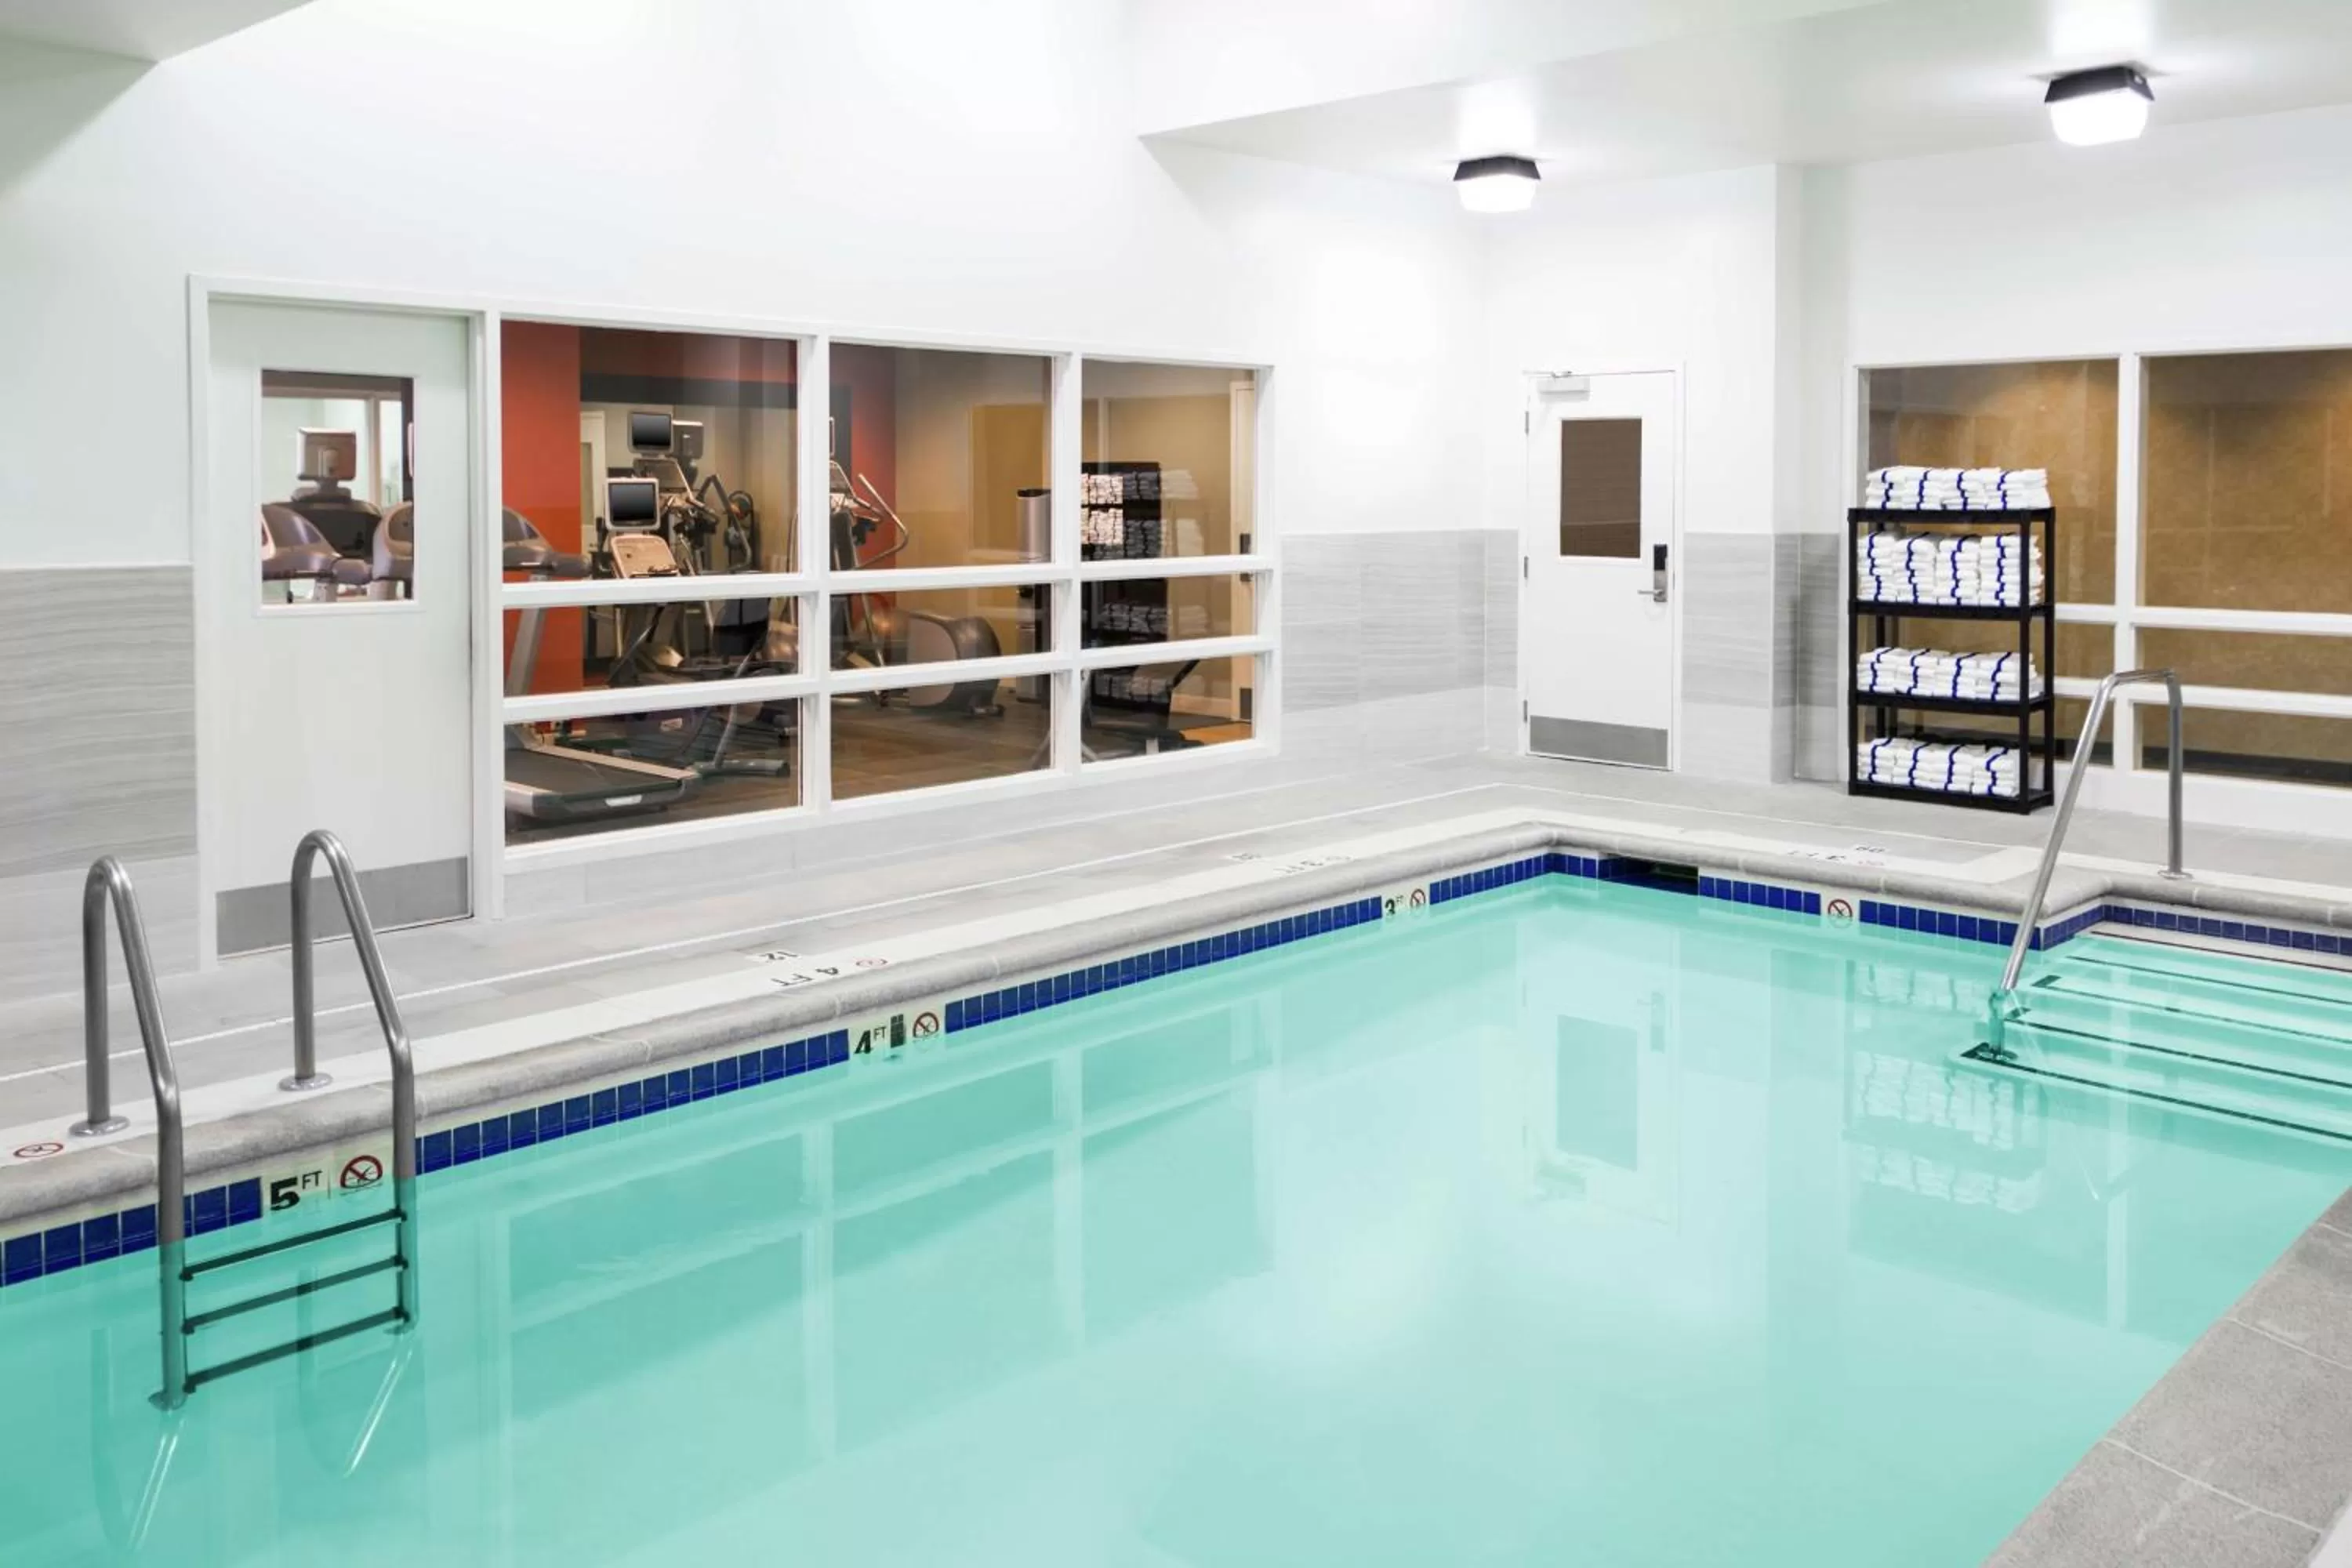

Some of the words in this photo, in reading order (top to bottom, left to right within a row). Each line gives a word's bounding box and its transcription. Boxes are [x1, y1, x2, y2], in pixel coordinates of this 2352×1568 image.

[771, 974, 814, 986] FT
[854, 1029, 872, 1054] 4
[873, 1025, 887, 1041] FT
[270, 1177, 299, 1211] 5
[302, 1171, 323, 1189] FT
